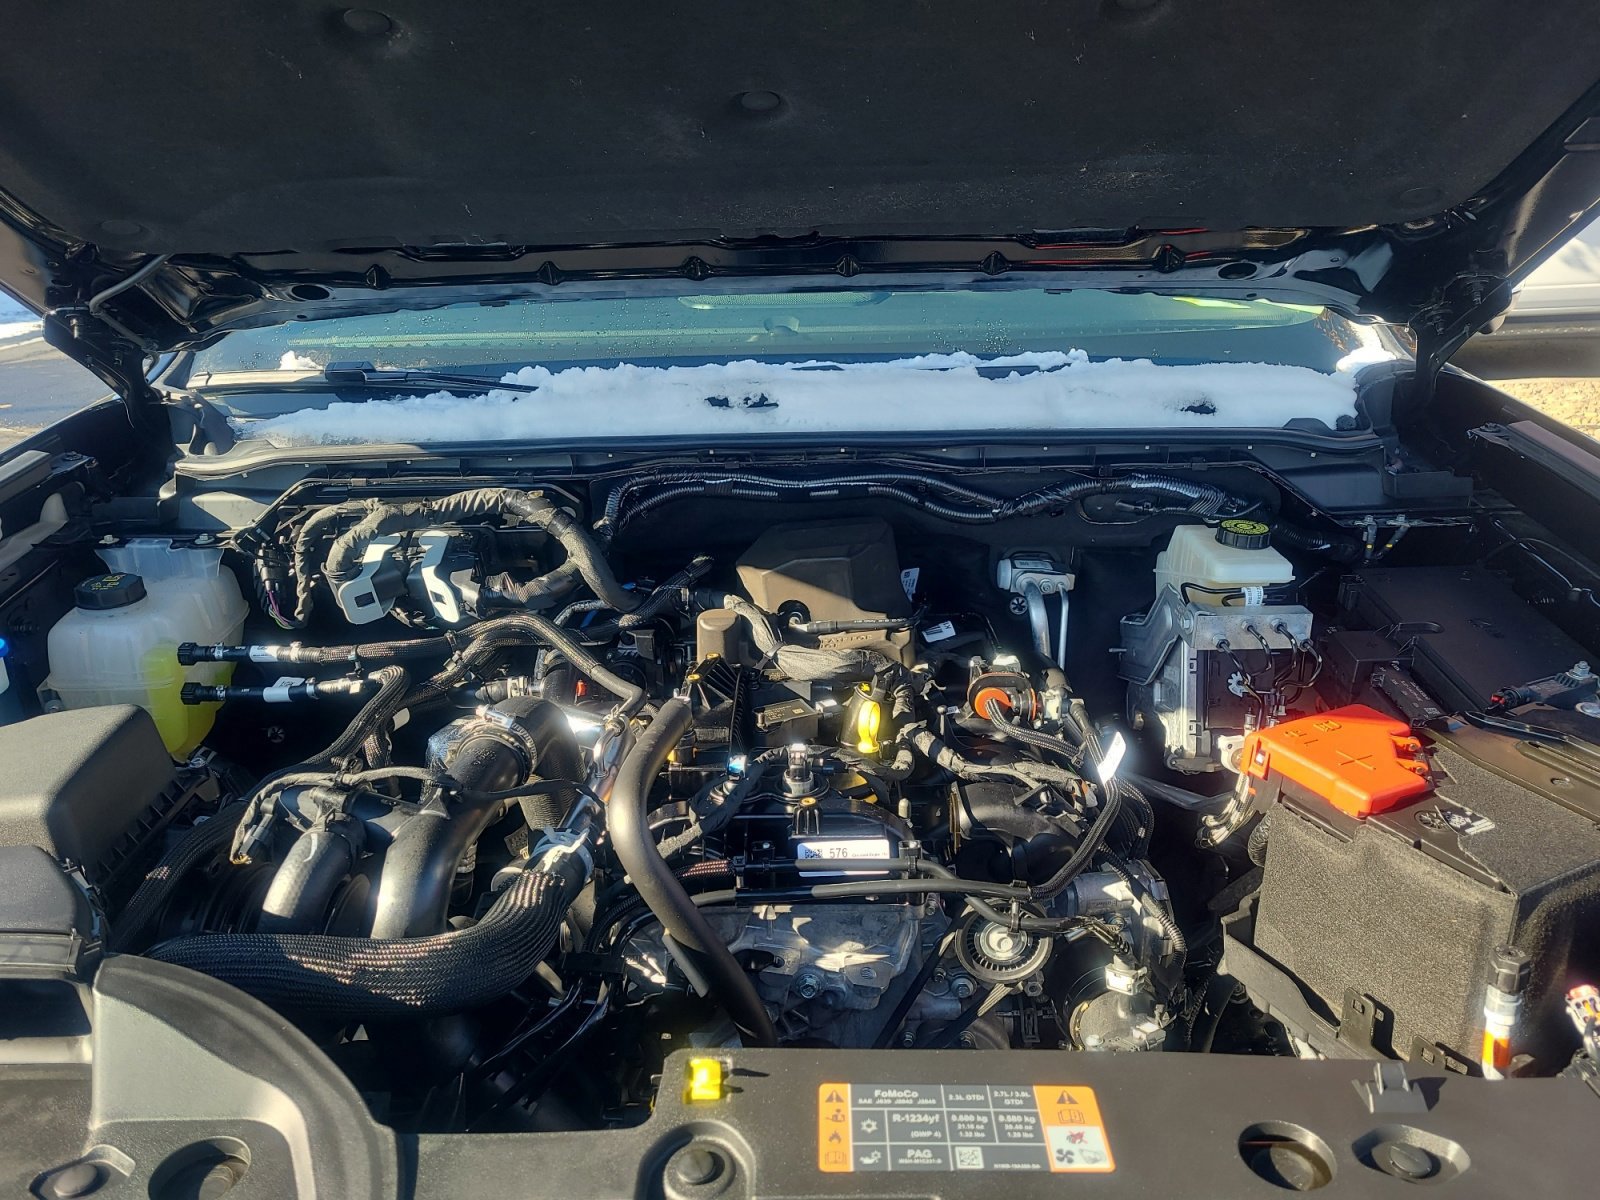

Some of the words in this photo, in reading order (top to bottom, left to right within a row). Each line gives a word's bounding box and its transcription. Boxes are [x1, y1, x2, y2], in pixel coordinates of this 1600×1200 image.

[829, 848, 848, 859] 576
[874, 1089, 919, 1098] FoMoCo
[892, 1113, 940, 1124] R-1234yf
[976, 1115, 989, 1124] kg
[1023, 1115, 1037, 1124] kg
[907, 1149, 933, 1158] PAG
